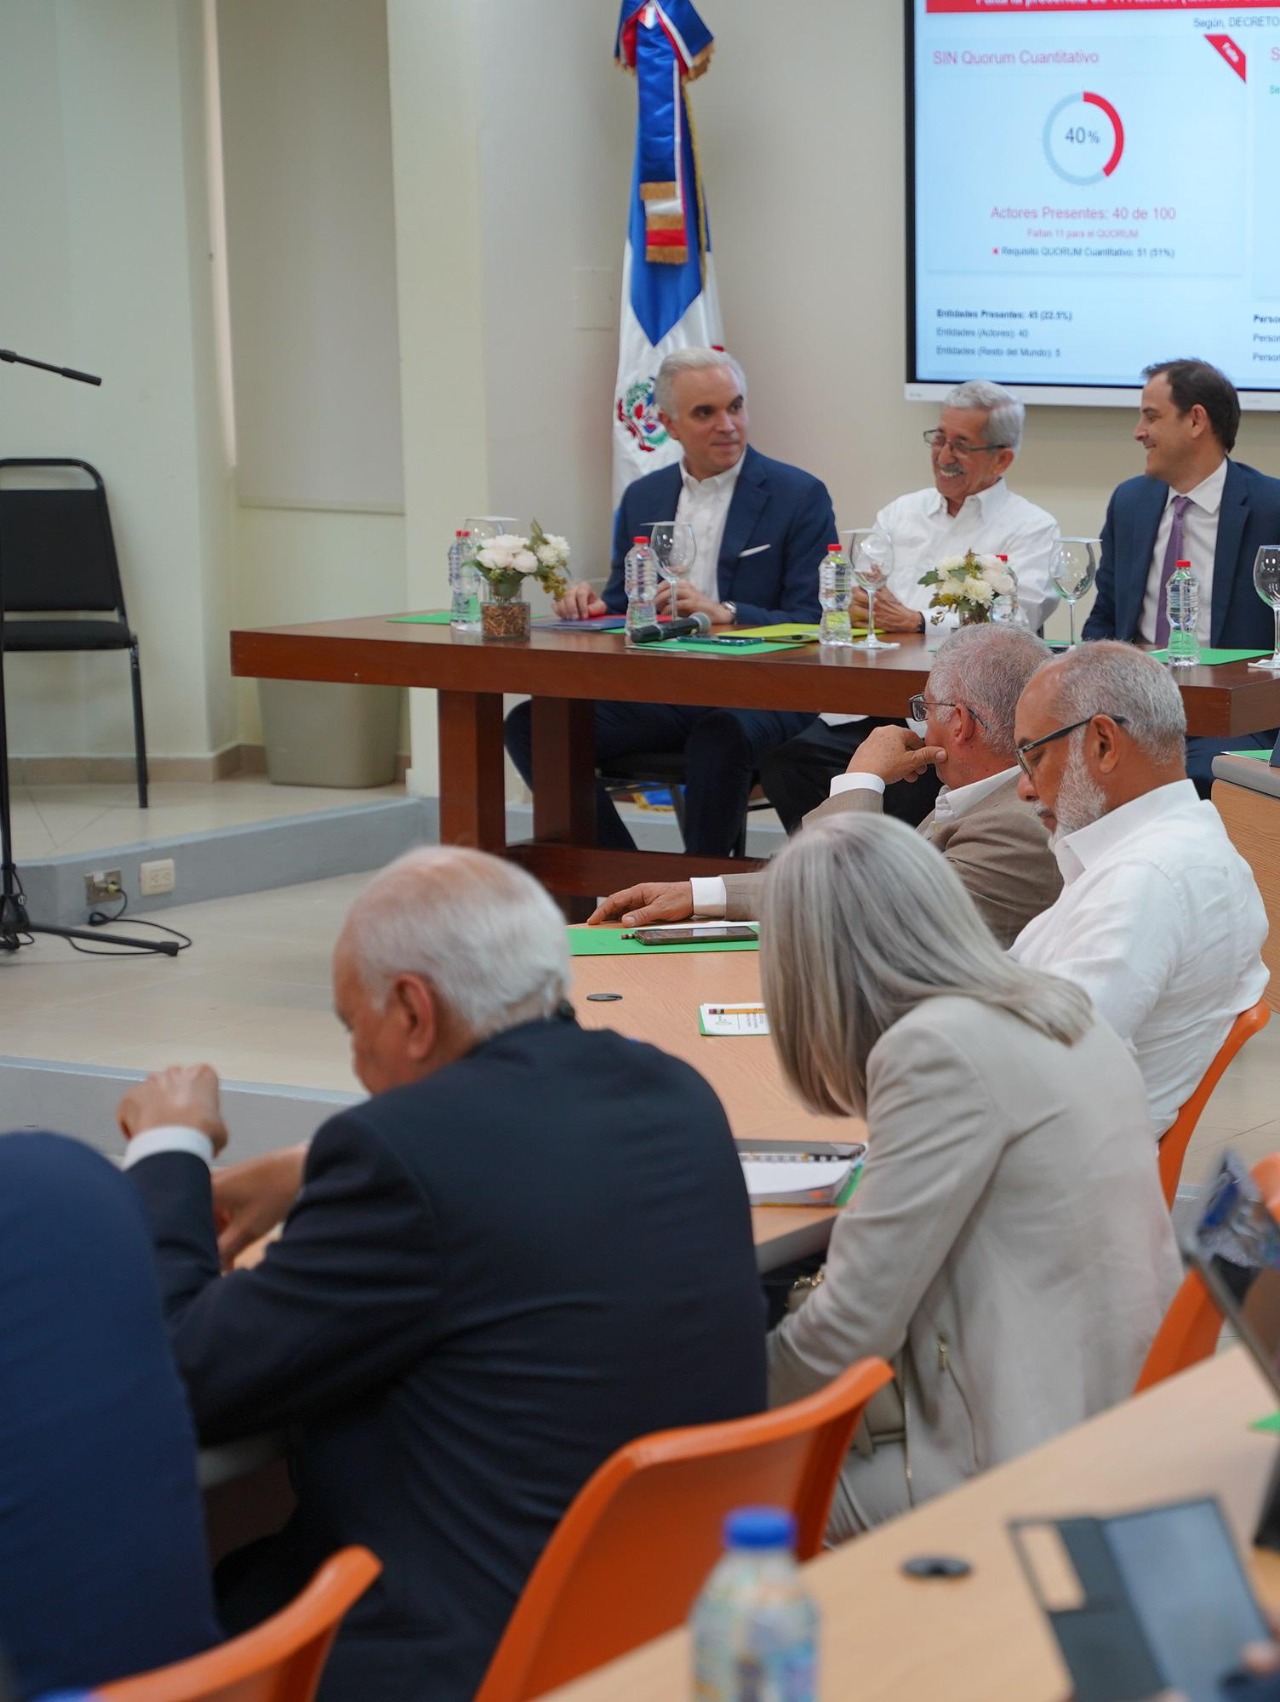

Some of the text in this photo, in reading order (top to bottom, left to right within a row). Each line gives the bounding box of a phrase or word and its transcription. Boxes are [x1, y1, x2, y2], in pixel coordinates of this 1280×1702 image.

[1228, 16, 1280, 28] DECRETO
[933, 49, 1100, 65] SIN Quorum Cuantitativo
[990, 207, 1177, 221] Actores Presentes: 40 de 100
